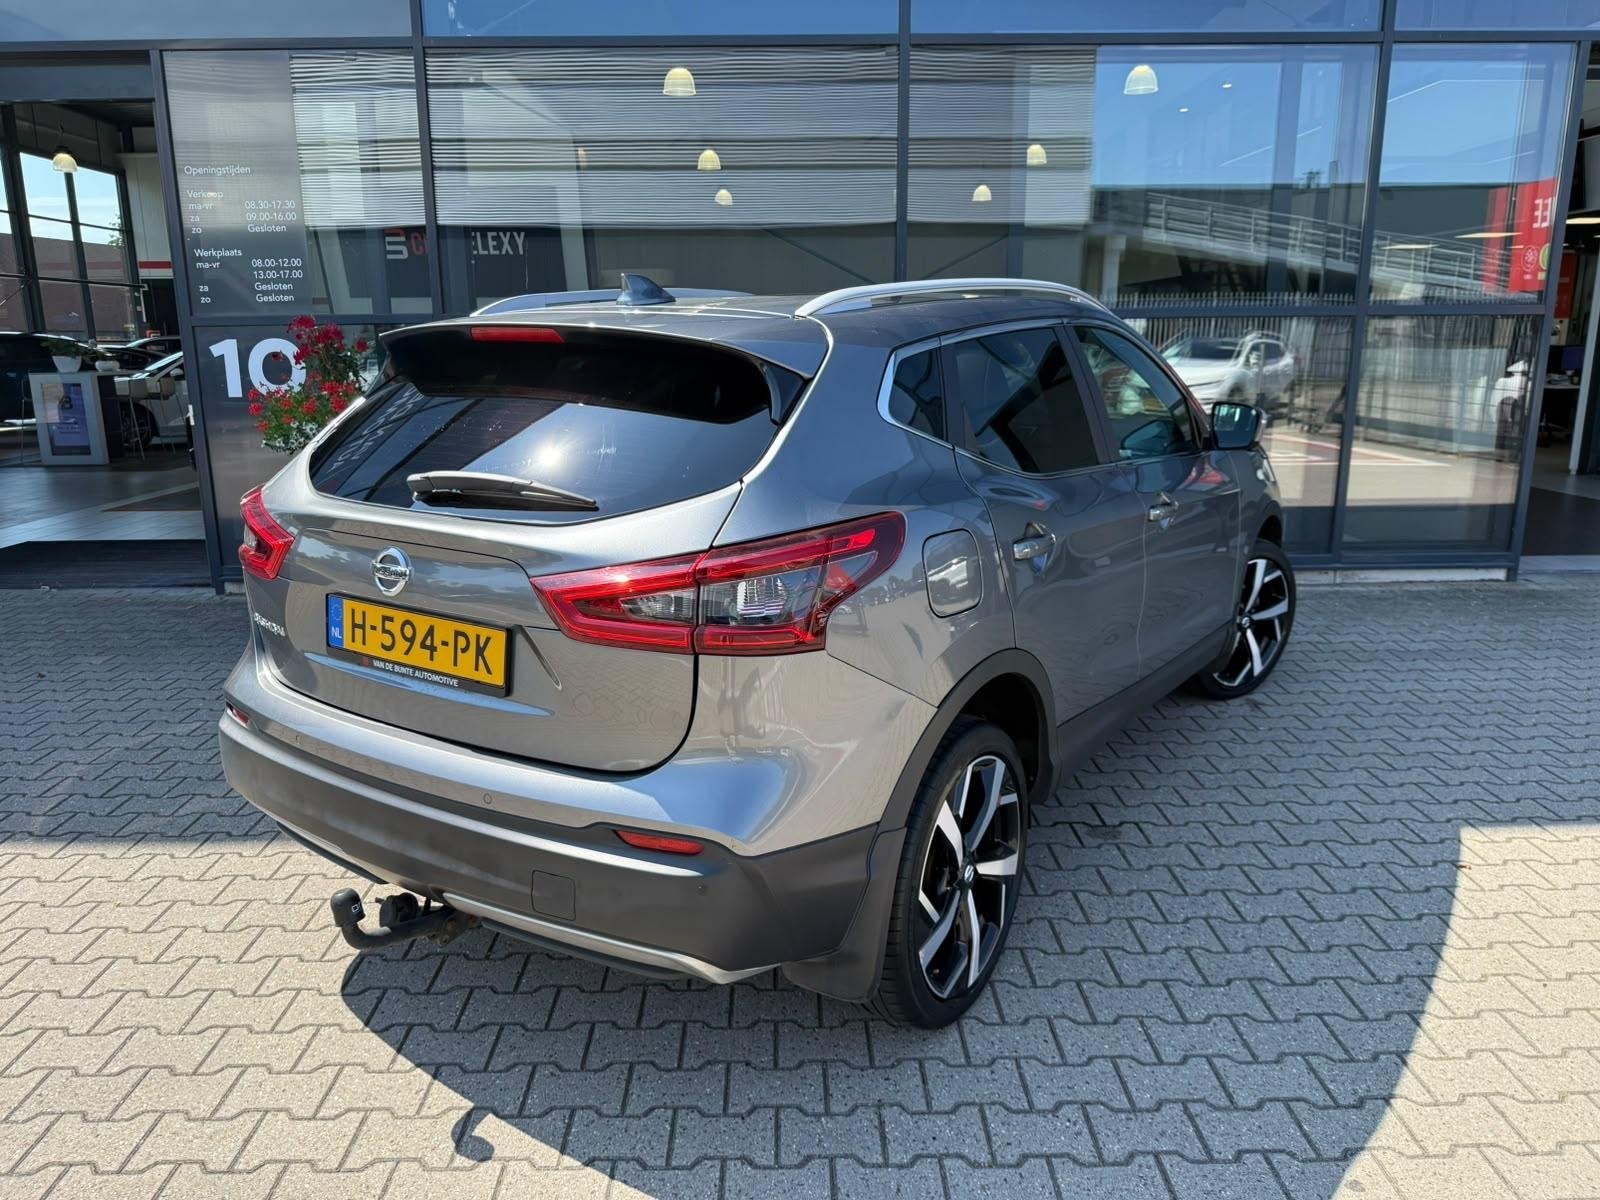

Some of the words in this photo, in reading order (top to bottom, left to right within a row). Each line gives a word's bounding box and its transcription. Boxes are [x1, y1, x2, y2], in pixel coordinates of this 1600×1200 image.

[184, 165, 251, 176] Openingstijden
[187, 190, 223, 200] Verkoop
[245, 200, 296, 209] 08.30-17.30
[246, 212, 297, 221] 09.00-16.00
[248, 224, 287, 233] Gesloten
[194, 248, 243, 258] Werkplaats
[196, 261, 221, 269] ma-vr
[251, 258, 302, 267] 08.00-12.00
[253, 270, 303, 279] 13.00-17.00
[254, 282, 293, 291] Gesloten
[200, 296, 211, 304] zo
[256, 293, 295, 302] Gesloten
[209, 338, 306, 397] 10
[331, 625, 343, 639] NL
[350, 608, 493, 675] H-594-PK
[373, 659, 385, 669] VAN
[385, 662, 394, 672] DE
[394, 665, 414, 677] BUNTE
[414, 670, 459, 687] AUTOMOTIVE
